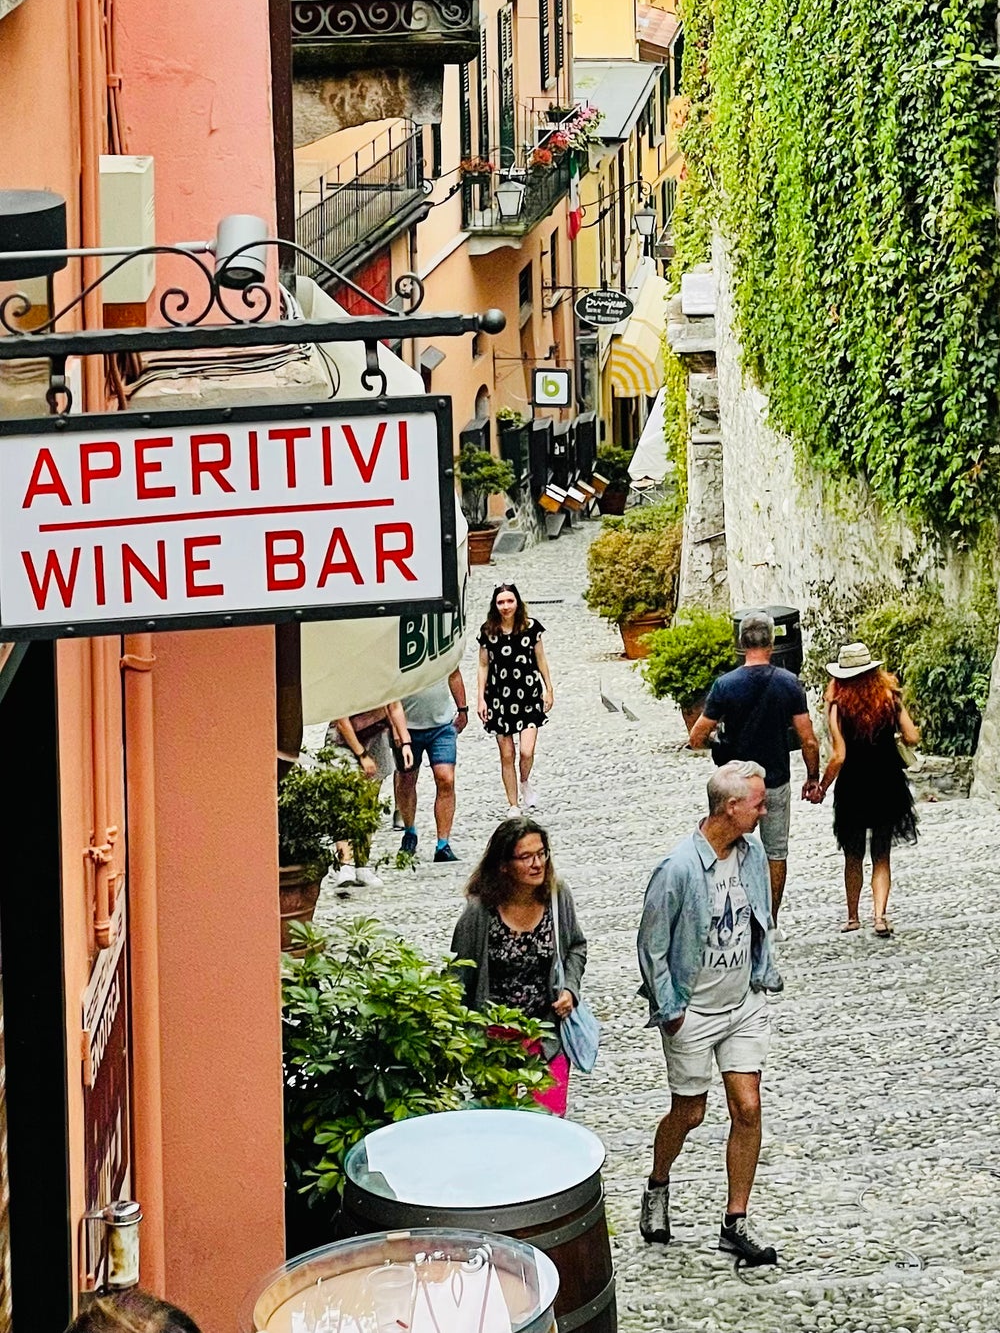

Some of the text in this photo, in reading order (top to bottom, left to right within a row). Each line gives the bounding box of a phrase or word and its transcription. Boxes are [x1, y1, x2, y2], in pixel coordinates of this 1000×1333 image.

[22, 421, 410, 509] APERITIVI
[21, 522, 418, 610] WINE BAR
